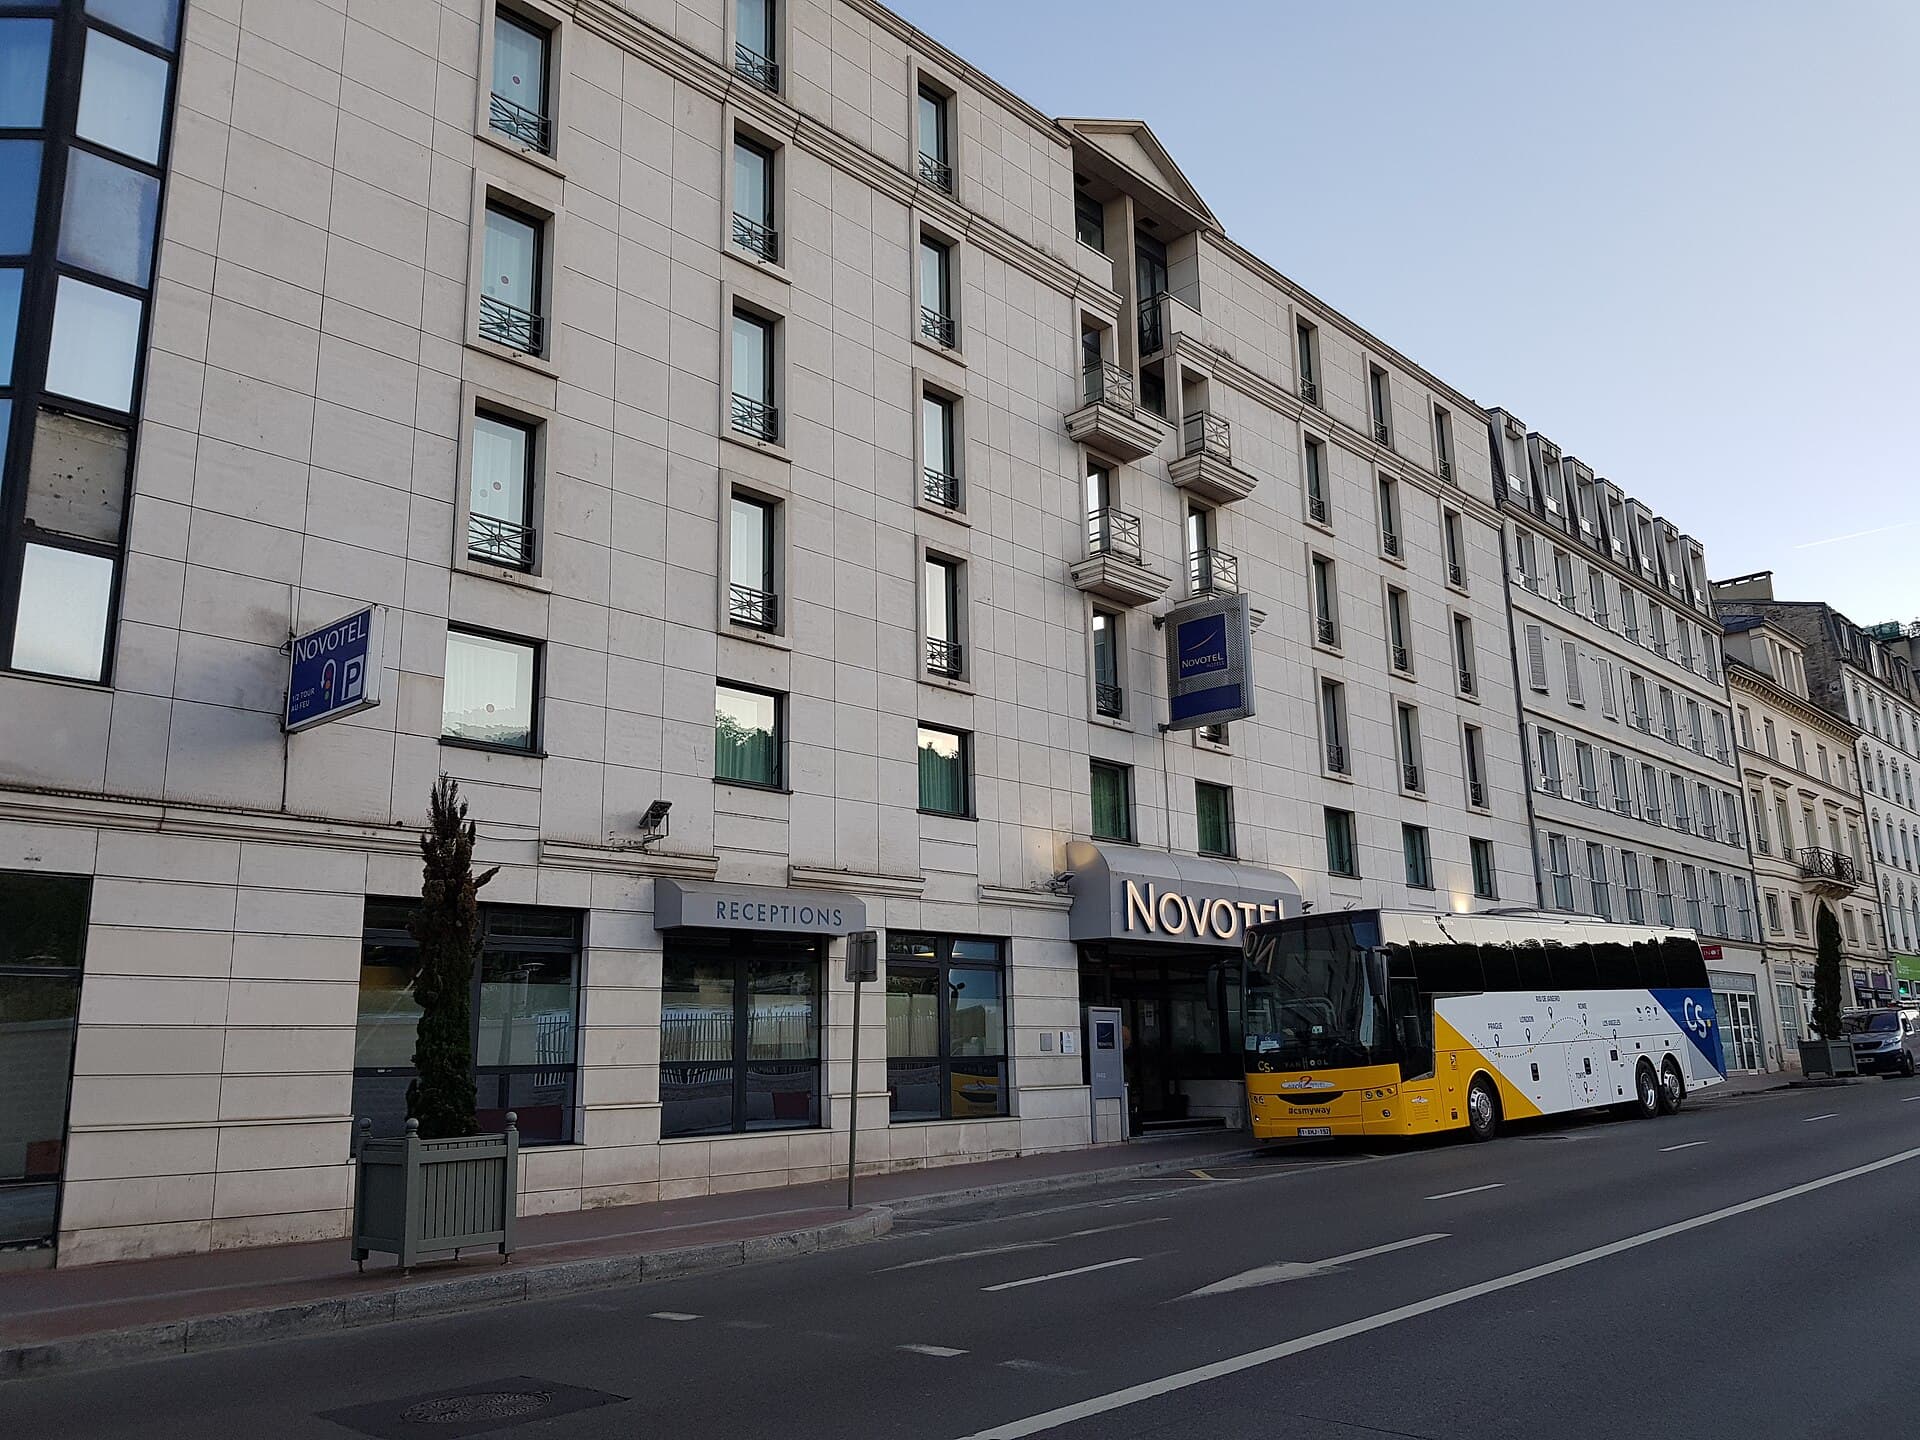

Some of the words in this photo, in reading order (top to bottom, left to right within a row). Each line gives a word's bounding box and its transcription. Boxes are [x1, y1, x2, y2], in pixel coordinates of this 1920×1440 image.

[295, 615, 367, 665] NOVOTEL
[1182, 651, 1224, 669] NOVOTEL
[344, 661, 361, 699] P
[300, 687, 315, 698] TOUR
[290, 703, 299, 712] AU
[299, 699, 310, 709] FEU
[716, 900, 843, 927] RECEPTIONS
[1288, 1106, 1331, 1116] #csmyway
